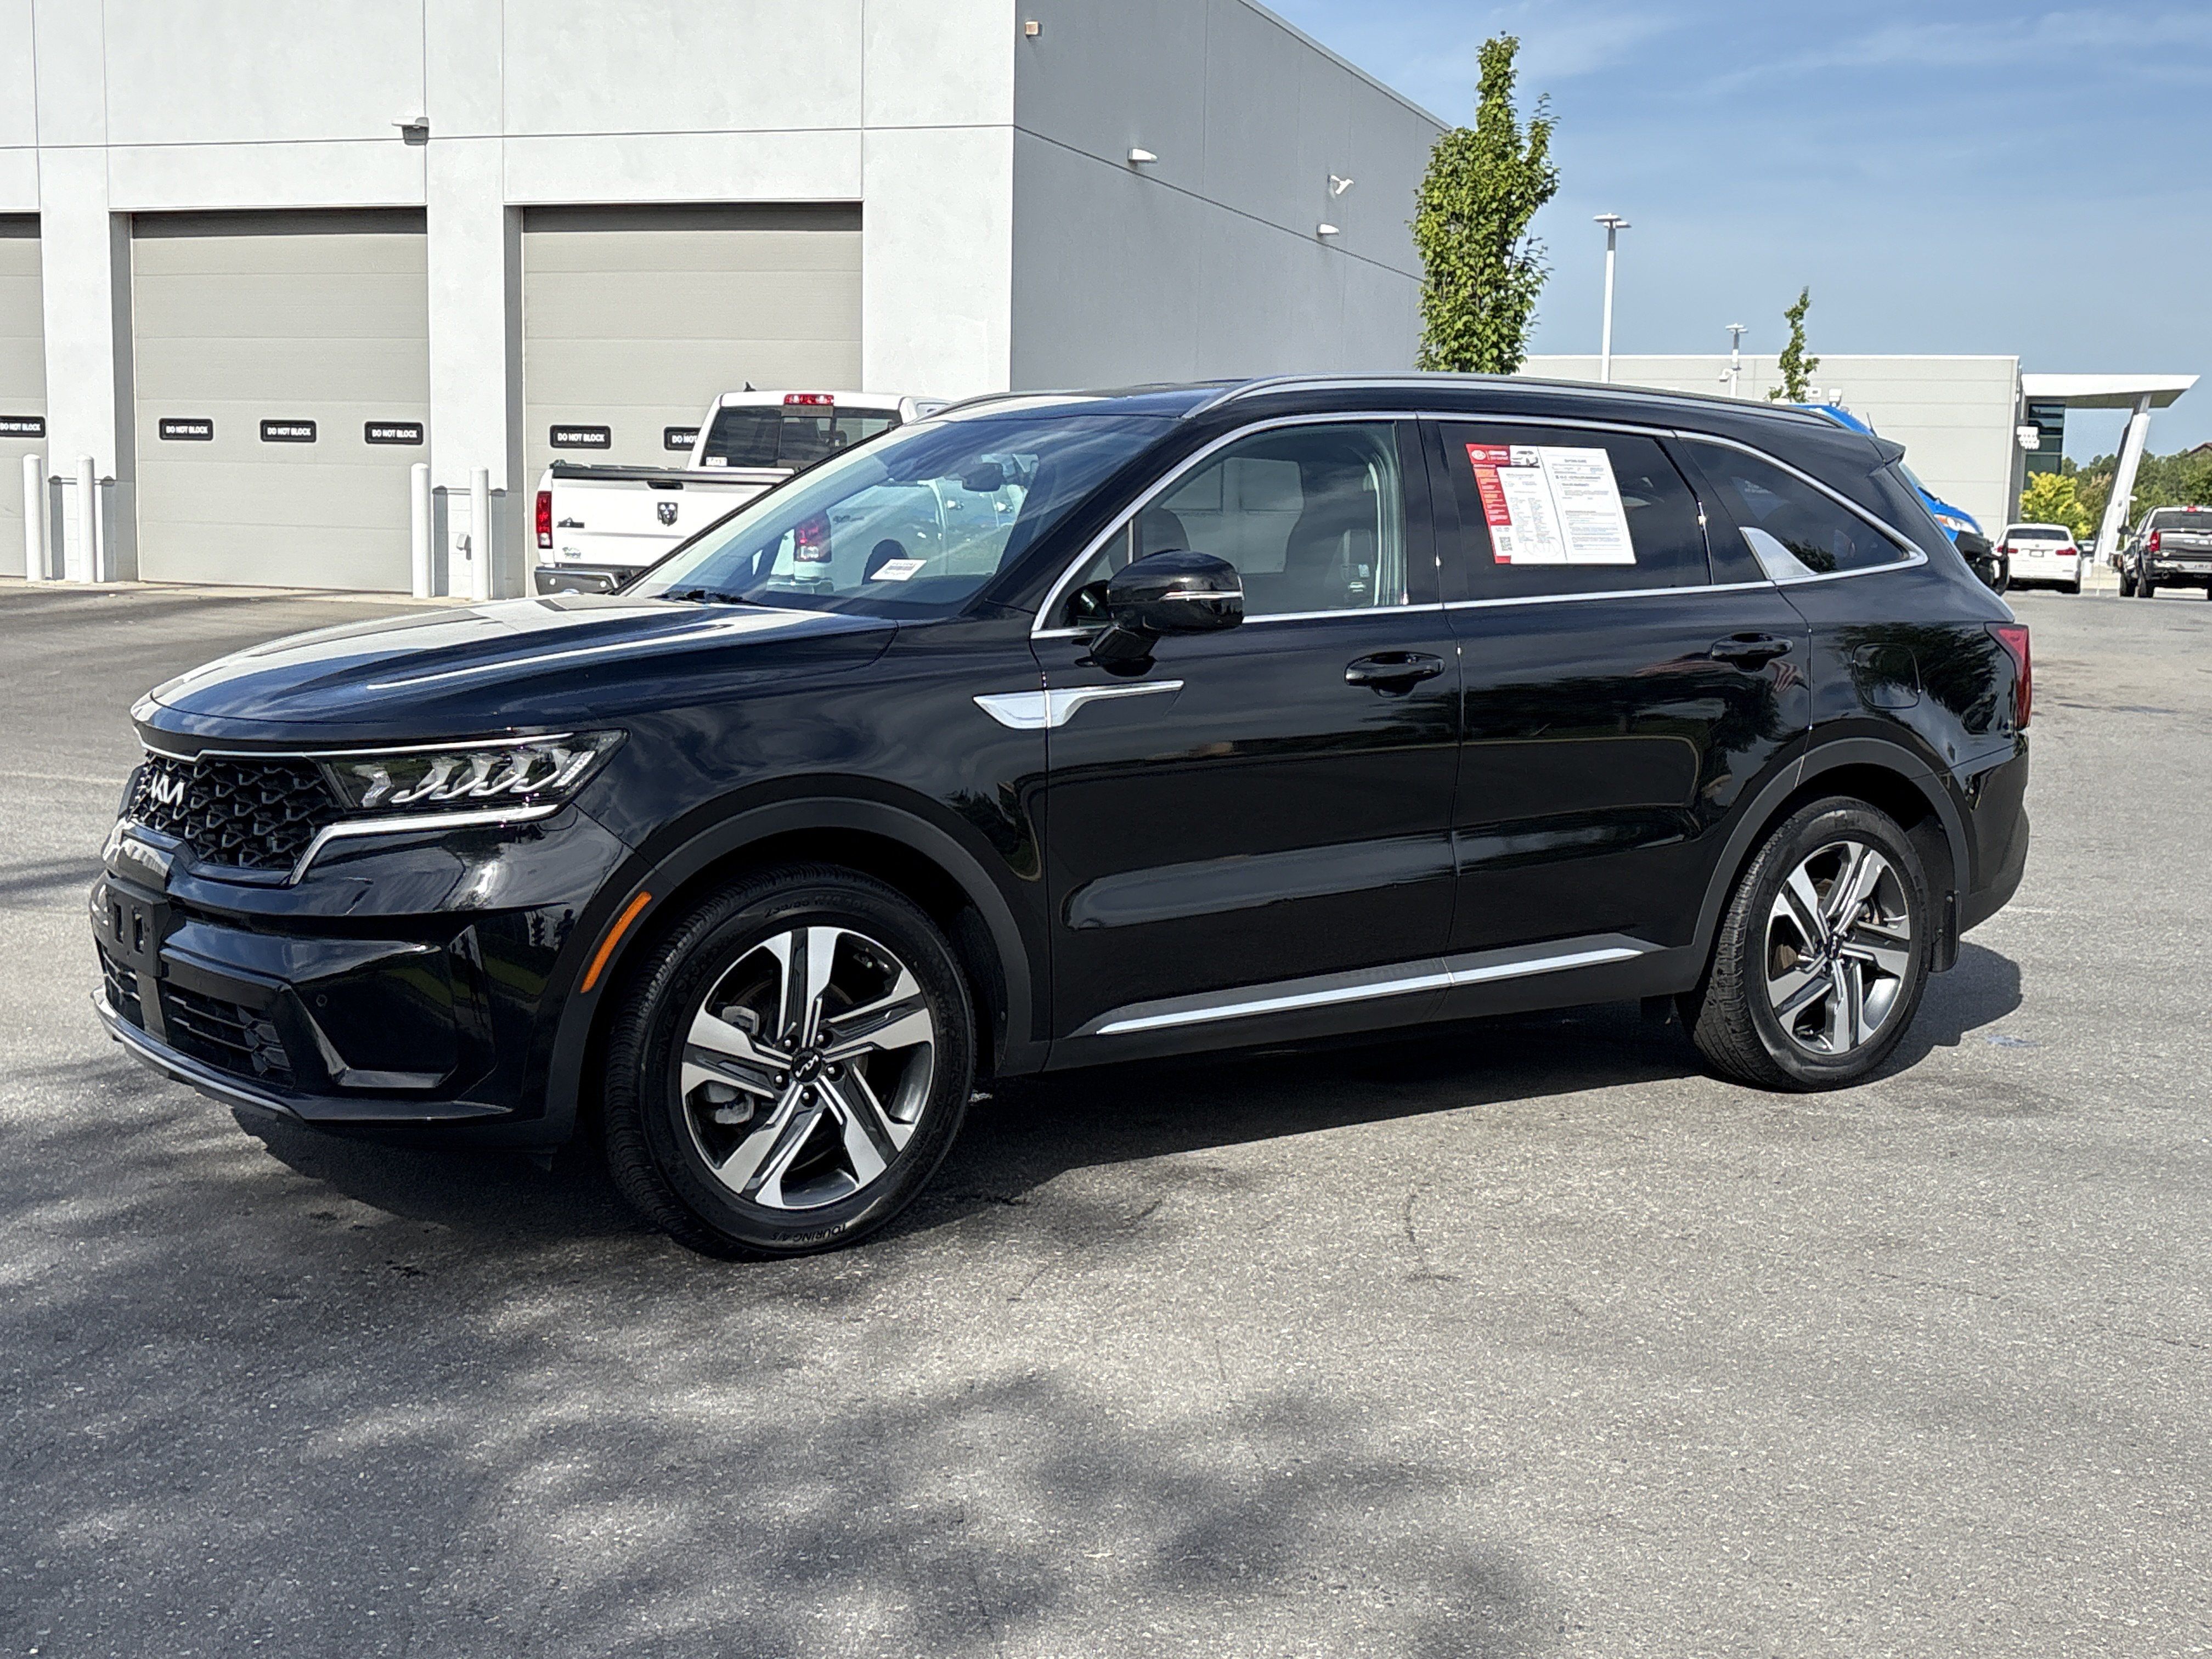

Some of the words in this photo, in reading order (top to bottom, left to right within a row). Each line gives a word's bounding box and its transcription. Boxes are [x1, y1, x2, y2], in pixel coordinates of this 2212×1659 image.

[22, 423, 41, 431] BLOCK
[166, 425, 175, 433] DO
[176, 426, 188, 434] NOT
[188, 426, 208, 434] BLOCK
[278, 427, 290, 436] NOT
[291, 427, 311, 436] BLOCK
[372, 429, 382, 437] DO
[382, 429, 396, 438] NOT
[396, 430, 417, 438] BLOCK
[557, 432, 568, 441] DO
[568, 432, 582, 442] NOT
[583, 433, 605, 442] BLOCK
[672, 435, 682, 444] DO
[793, 1221, 847, 1242] TOURING
